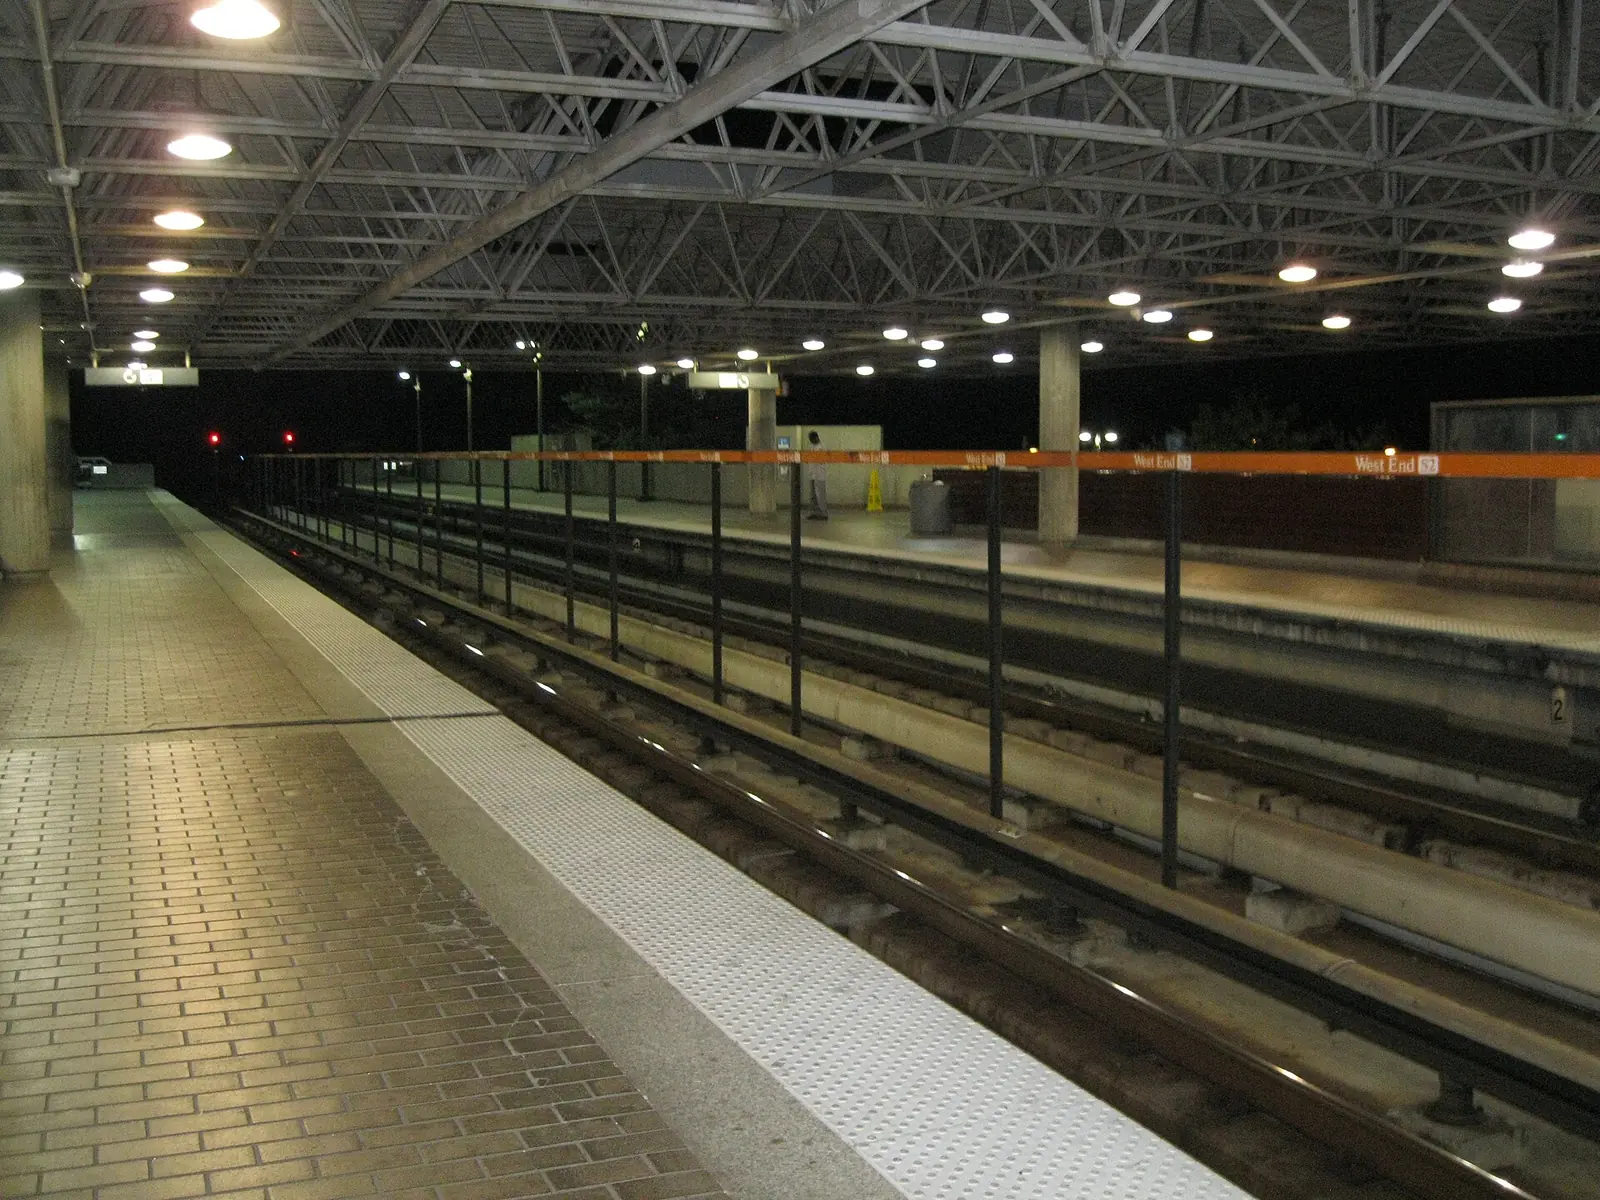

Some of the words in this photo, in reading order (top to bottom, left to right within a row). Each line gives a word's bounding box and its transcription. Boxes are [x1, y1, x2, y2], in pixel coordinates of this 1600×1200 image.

[1133, 453, 1154, 468] West
[1156, 453, 1175, 468] End
[1355, 455, 1384, 473] West
[1388, 455, 1416, 473] End
[1554, 698, 1563, 721] 2
